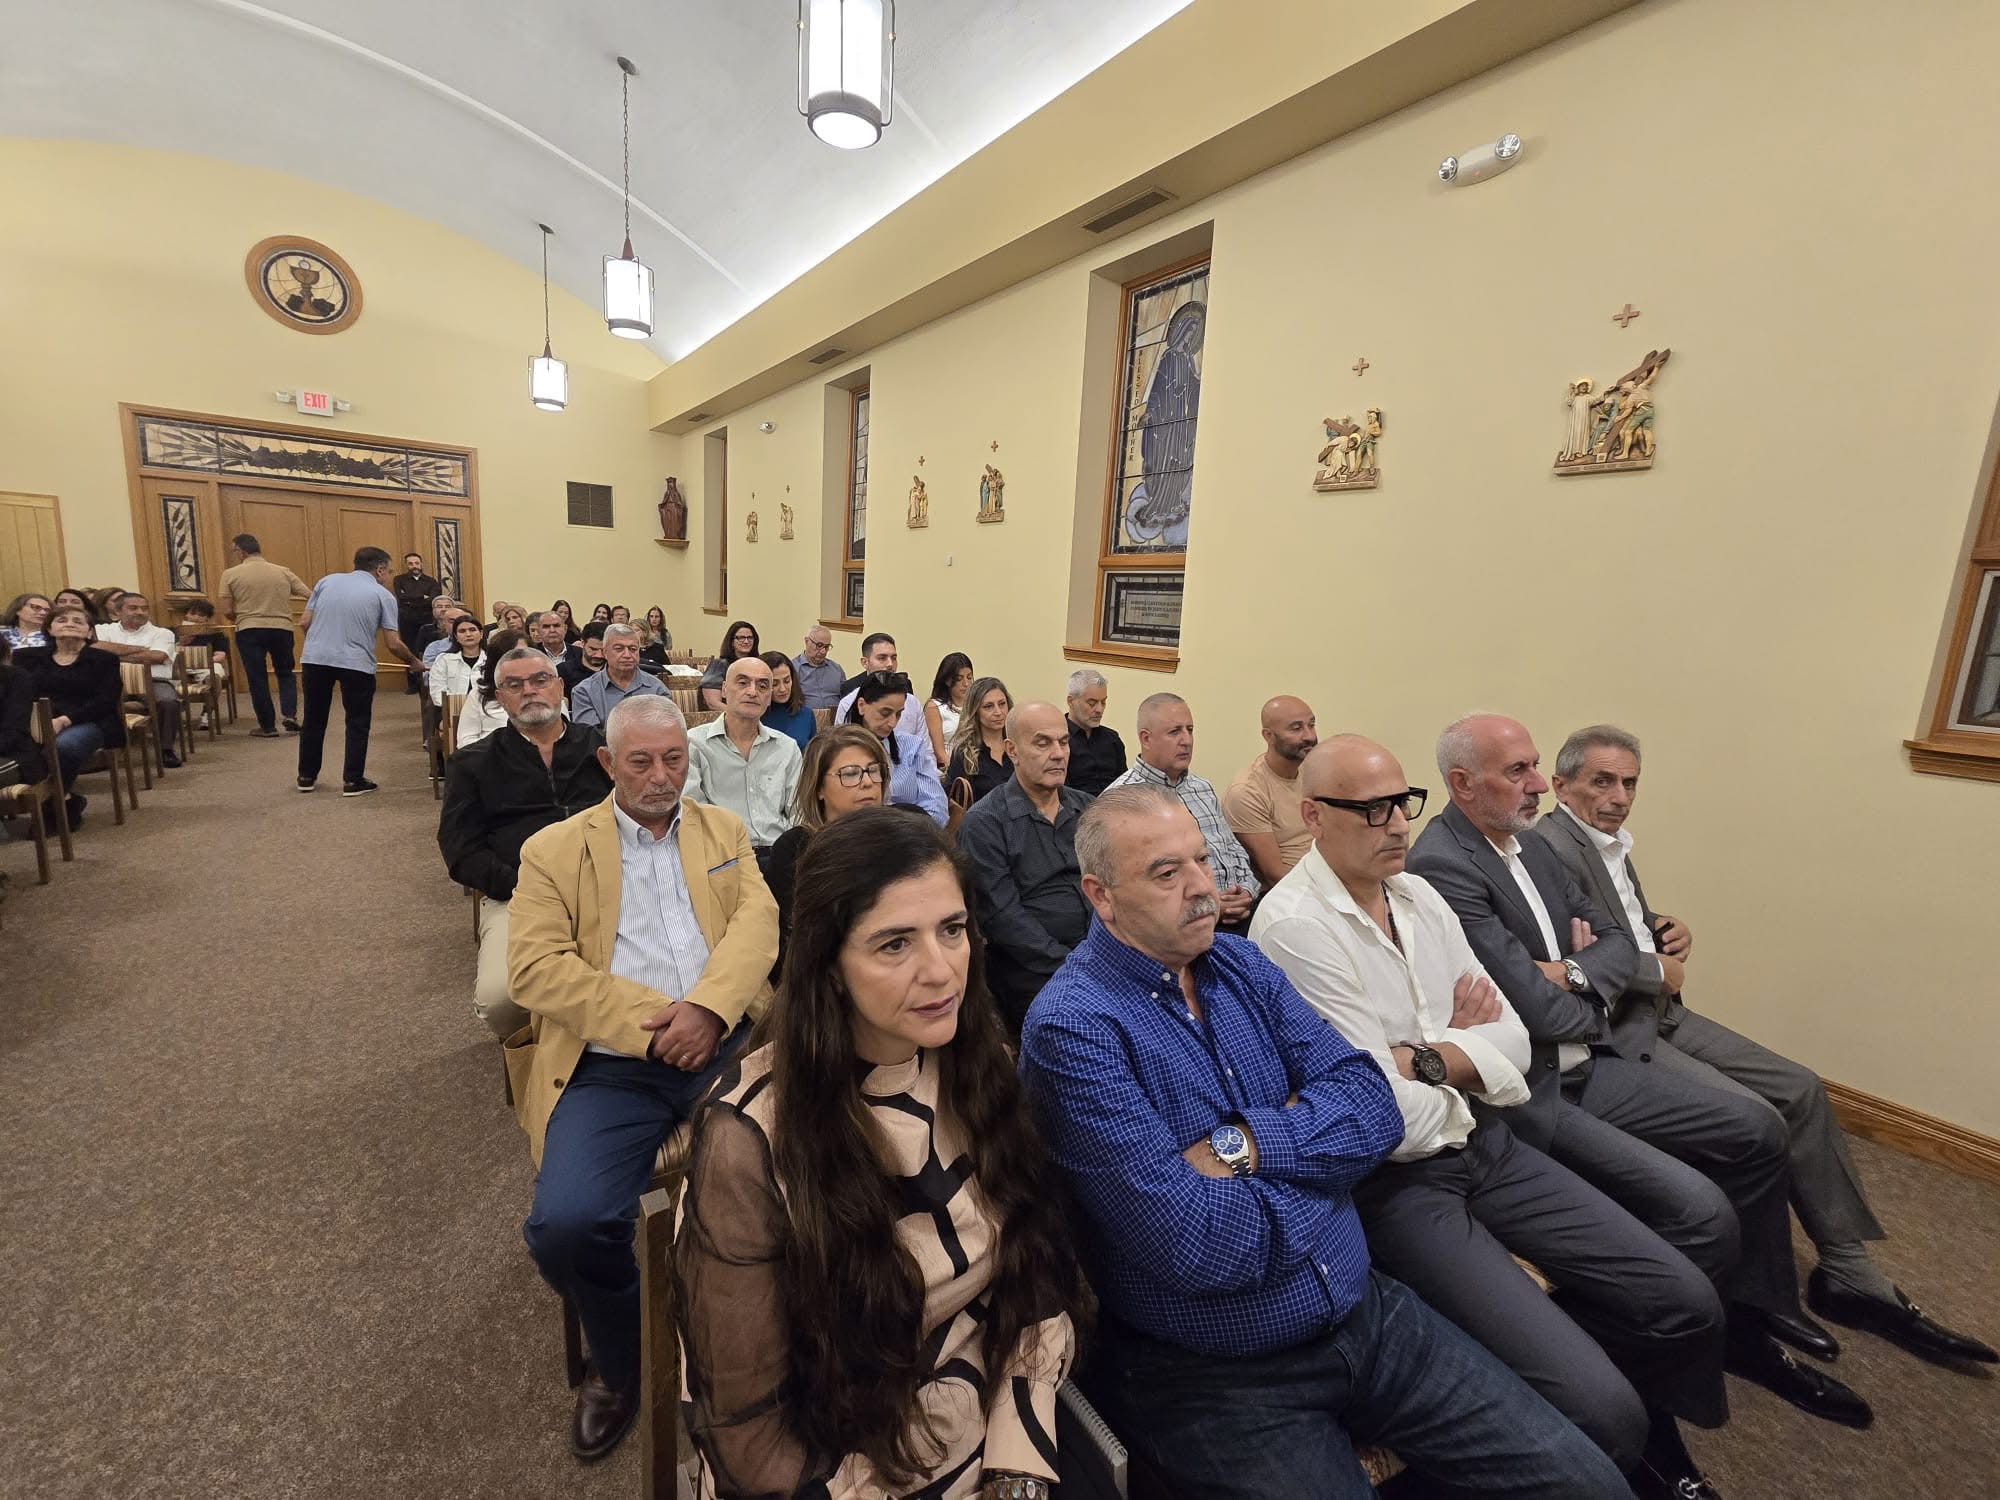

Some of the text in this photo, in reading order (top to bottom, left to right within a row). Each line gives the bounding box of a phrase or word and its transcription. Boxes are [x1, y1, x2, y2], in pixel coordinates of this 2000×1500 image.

[303, 392, 328, 409] EXIT
[1129, 350, 1143, 461] BLESSED MOTHER
